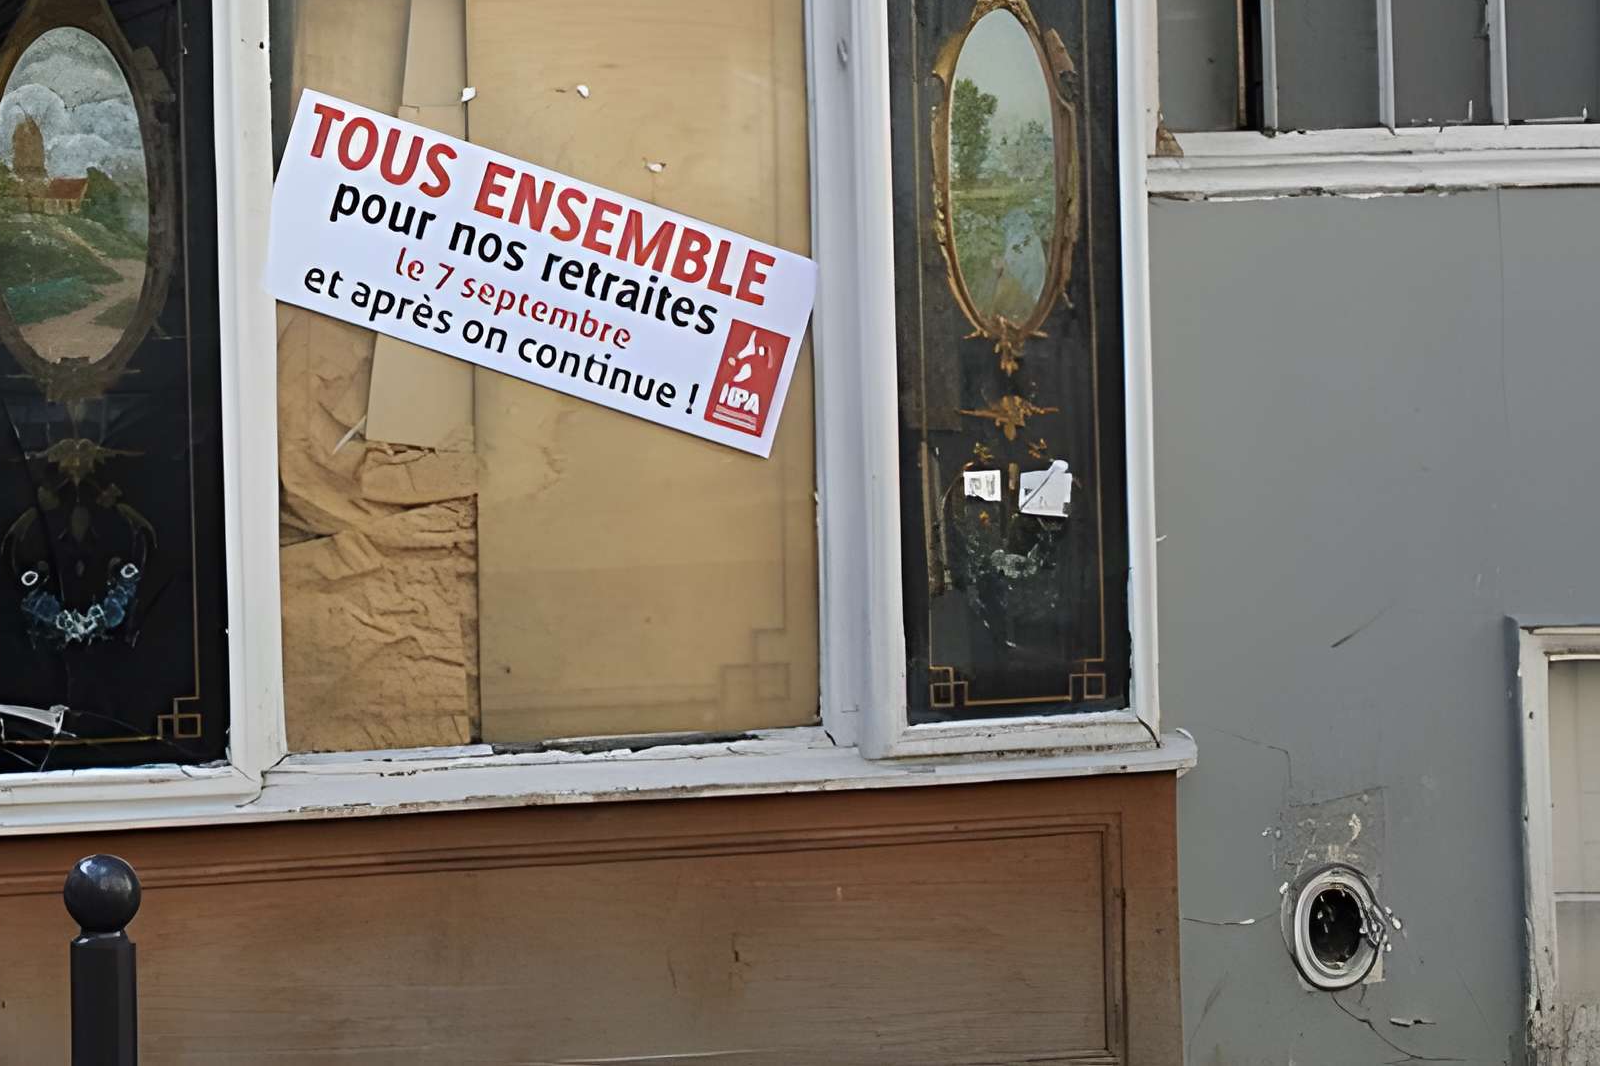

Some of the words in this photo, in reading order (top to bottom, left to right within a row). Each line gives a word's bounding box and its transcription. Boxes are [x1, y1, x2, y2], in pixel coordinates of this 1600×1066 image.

[309, 102, 458, 199] TOUS
[473, 160, 777, 307] ENSEMBLE
[329, 183, 437, 240] pour
[448, 221, 527, 272] nos
[541, 252, 719, 336] retraites
[304, 266, 344, 299] et
[350, 281, 453, 335] après
[462, 319, 508, 354] on
[518, 338, 677, 409] continue
[395, 247, 425, 280] le
[435, 263, 455, 290] 7
[461, 276, 631, 350] septembre
